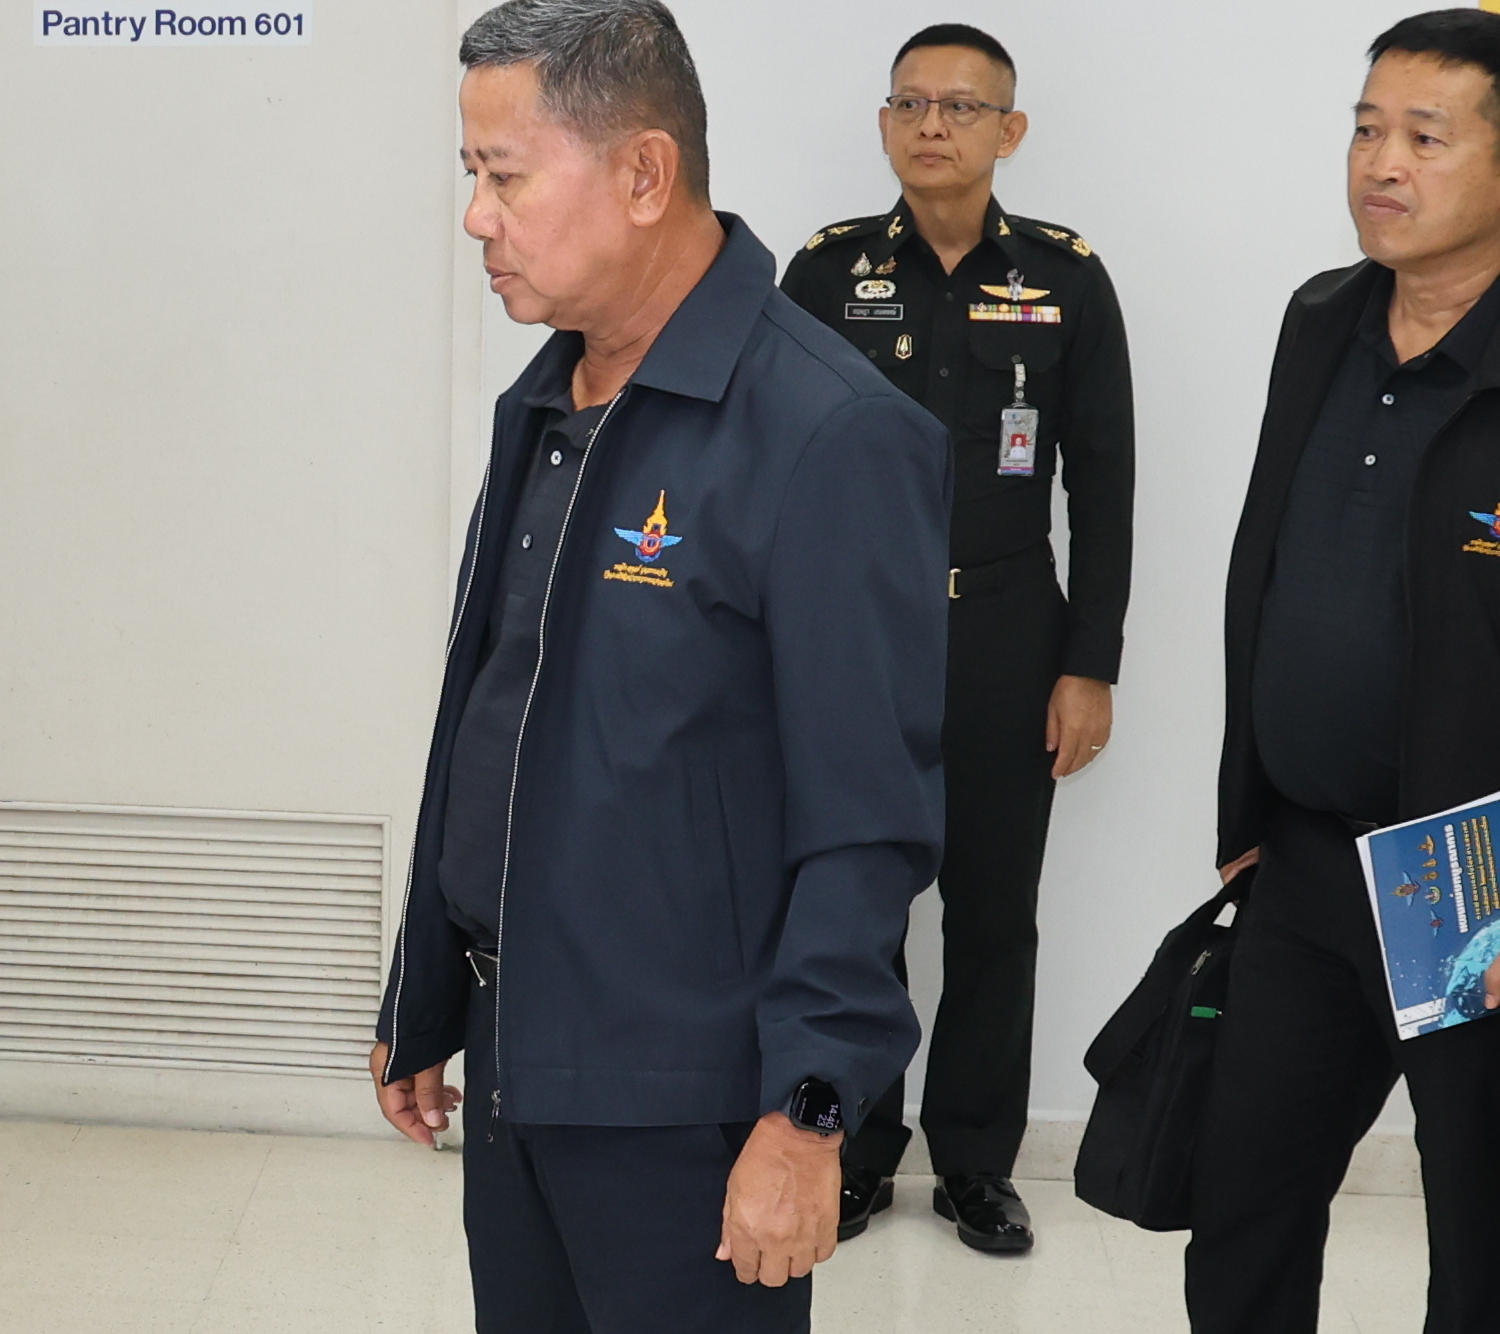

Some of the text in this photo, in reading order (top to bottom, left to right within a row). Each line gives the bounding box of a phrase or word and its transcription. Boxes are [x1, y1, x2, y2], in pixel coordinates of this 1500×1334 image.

[42, 9, 304, 42] Pantry Room 601
